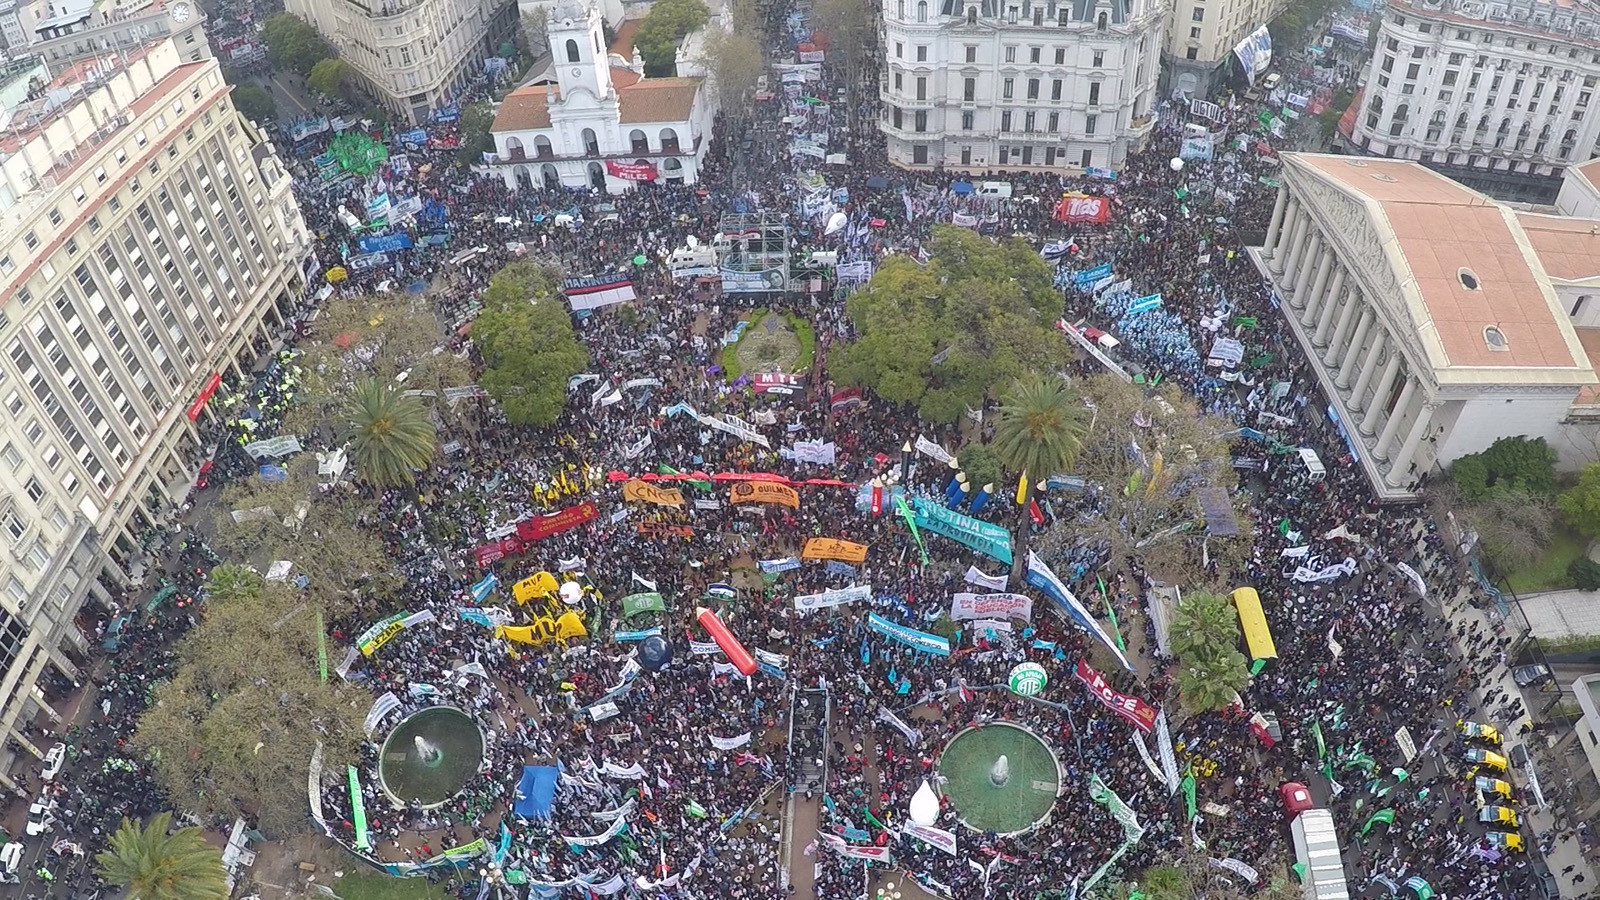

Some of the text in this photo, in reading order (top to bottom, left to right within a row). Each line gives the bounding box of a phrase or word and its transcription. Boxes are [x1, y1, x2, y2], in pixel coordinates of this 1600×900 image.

[189, 368, 207, 393] FRANCO
[209, 332, 233, 367] ARGENTINA
[636, 488, 678, 502] CNCT
